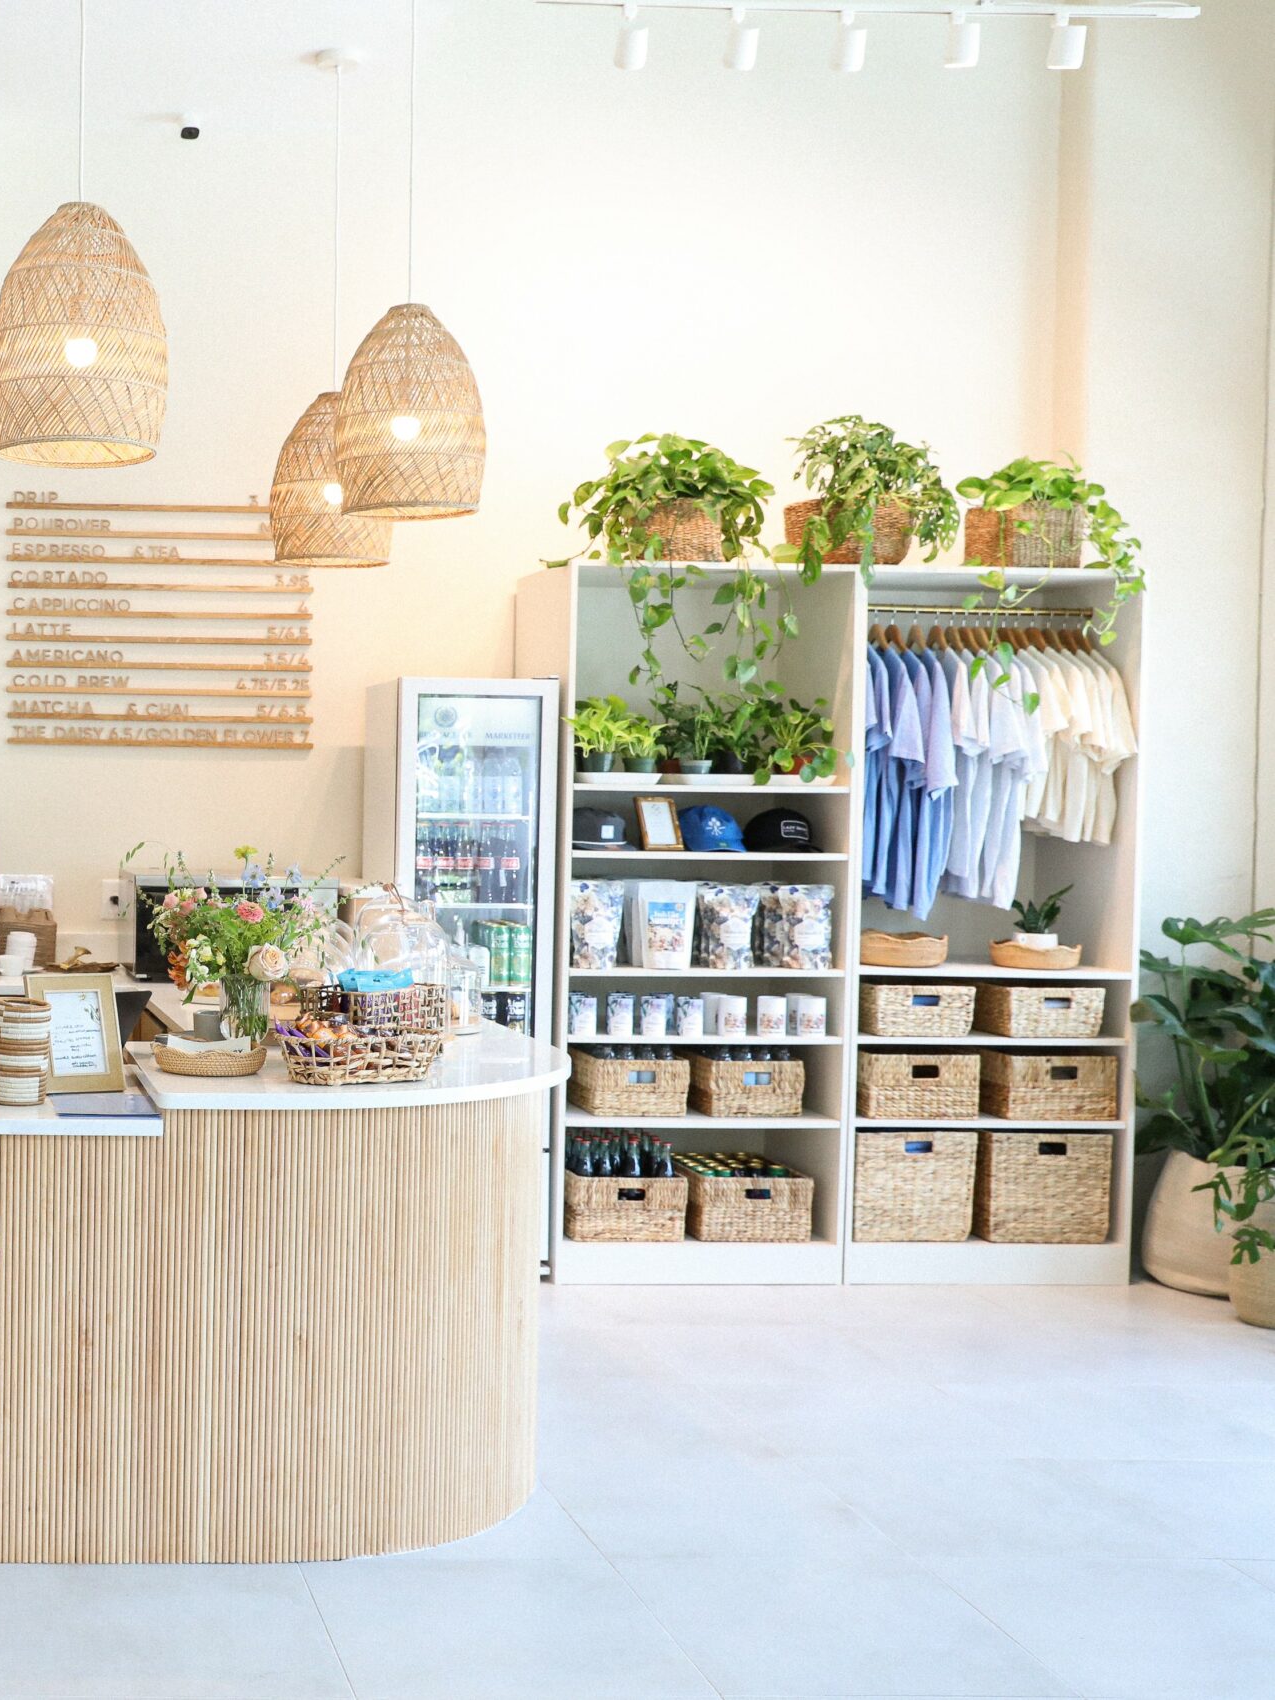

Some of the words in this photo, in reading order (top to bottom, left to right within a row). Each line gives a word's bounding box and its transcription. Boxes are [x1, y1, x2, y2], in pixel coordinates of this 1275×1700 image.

[13, 491, 59, 503] DRIP
[13, 517, 112, 531] POUROVER
[12, 543, 106, 557] ESPRESSO
[133, 546, 144, 558] &
[148, 546, 180, 559] TEA
[11, 570, 109, 584] CORTADO
[13, 597, 131, 612] CAPPUCCINO
[297, 601, 309, 613] 4
[12, 622, 72, 636] LATTE
[12, 649, 124, 663] AMERICANO
[13, 674, 67, 687] COLD
[77, 675, 130, 688] BREW
[12, 700, 94, 714] MATCHA
[127, 703, 138, 715] &
[146, 703, 189, 717] CHAI
[12, 725, 46, 738] THE
[54, 726, 104, 740] DAISY
[224, 729, 295, 743] FLOWER
